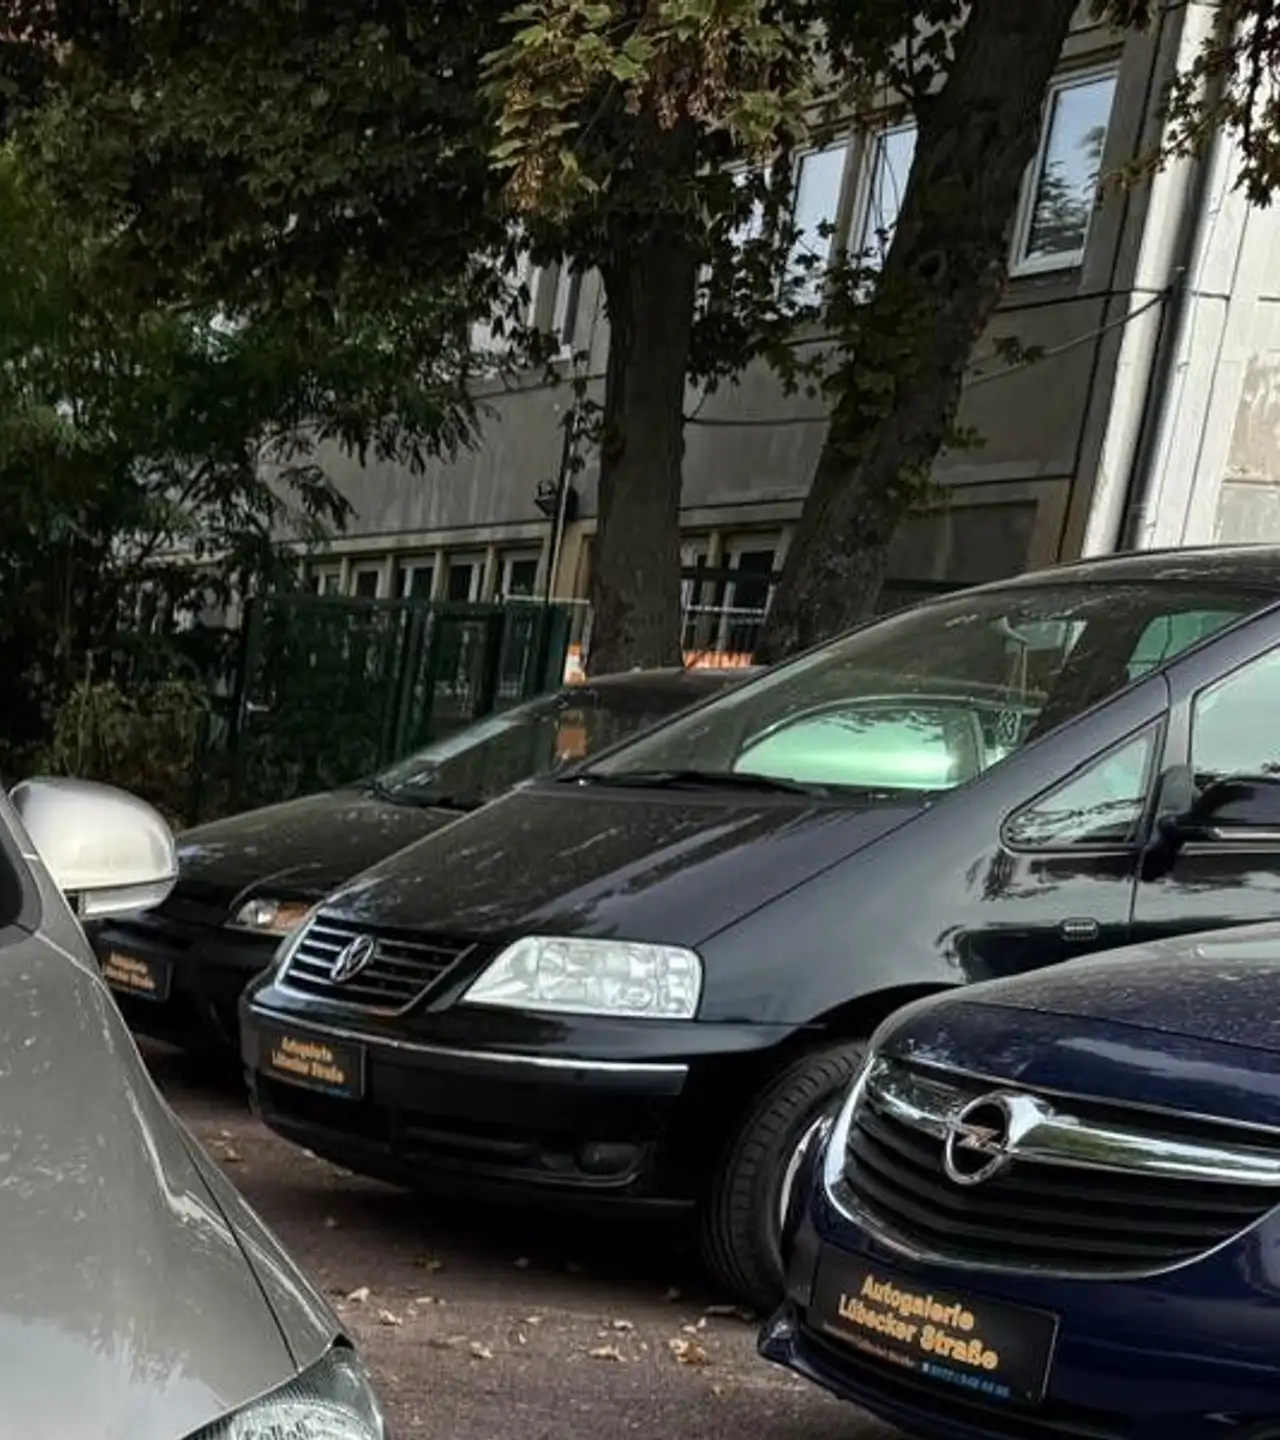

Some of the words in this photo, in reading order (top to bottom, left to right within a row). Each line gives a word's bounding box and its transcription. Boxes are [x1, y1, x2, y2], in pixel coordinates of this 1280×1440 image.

[838, 1293, 918, 1343] Lübecker
[919, 1323, 999, 1370] Straße
[860, 1274, 975, 1332] Autogalerie
